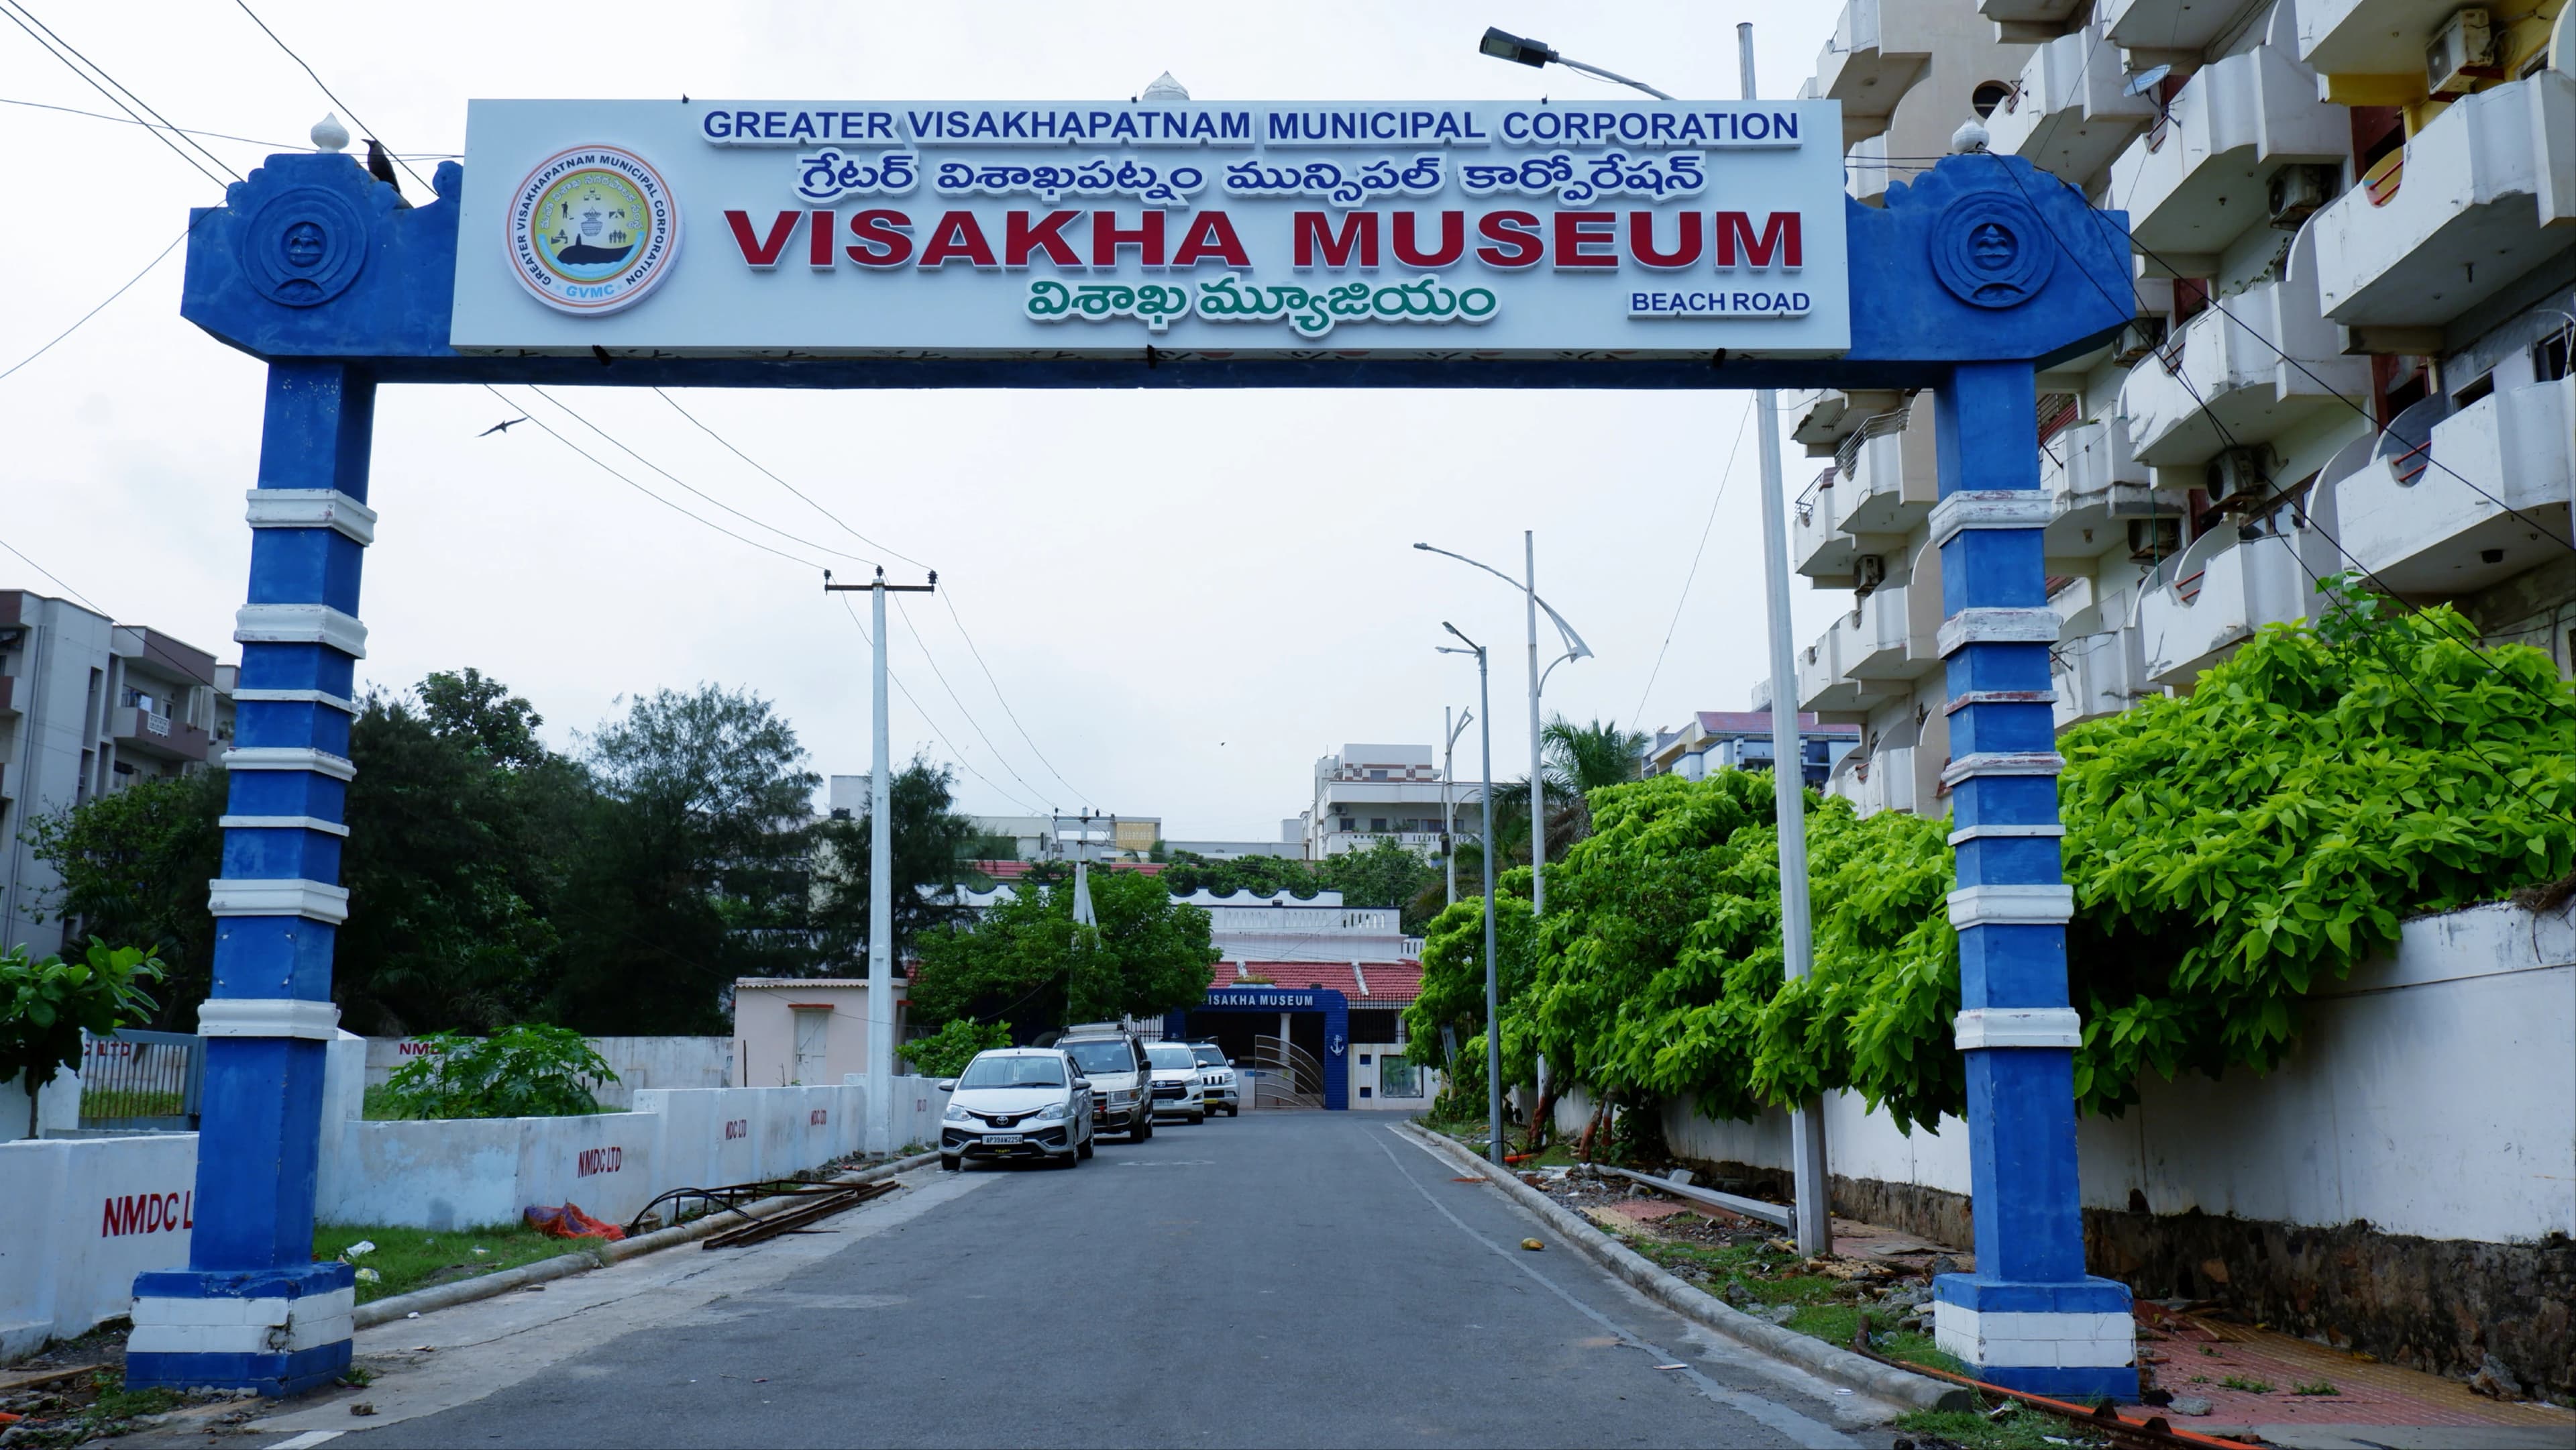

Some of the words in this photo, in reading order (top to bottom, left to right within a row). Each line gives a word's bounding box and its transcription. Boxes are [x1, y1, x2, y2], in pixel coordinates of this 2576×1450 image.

[704, 111, 893, 138] GREATER
[908, 111, 1250, 140] VISAKHAPATNAM
[1269, 111, 1486, 140] MUNICIPAL
[1503, 112, 1798, 140] CORPORATION
[517, 155, 596, 230] VISAKHAPATNAM
[600, 155, 659, 199] MUNICIPAL
[798, 152, 914, 198] గ్రేటర్
[937, 160, 1203, 201] విశాఖపట్నం
[1227, 158, 1440, 202] మున్సిపల్
[1463, 153, 1704, 201] కార్పోరేషన్
[517, 235, 551, 286] GREATER
[625, 201, 666, 286] CORPORATION
[725, 210, 1250, 266] VISAKHA
[1294, 211, 1802, 267] MUSEUM
[566, 284, 614, 298] GVMC
[1027, 280, 1187, 325] విశాఖ
[1199, 276, 1497, 332] మ్యూజియం
[1632, 293, 1726, 311] BEACH
[1733, 293, 1811, 311] ROAD
[1208, 994, 1256, 1006] ISAKHA
[1259, 994, 1313, 1006] MUSEUM
[578, 1148, 605, 1179] NMDC
[606, 1146, 621, 1173] LTD
[102, 1192, 179, 1238] NMDC
